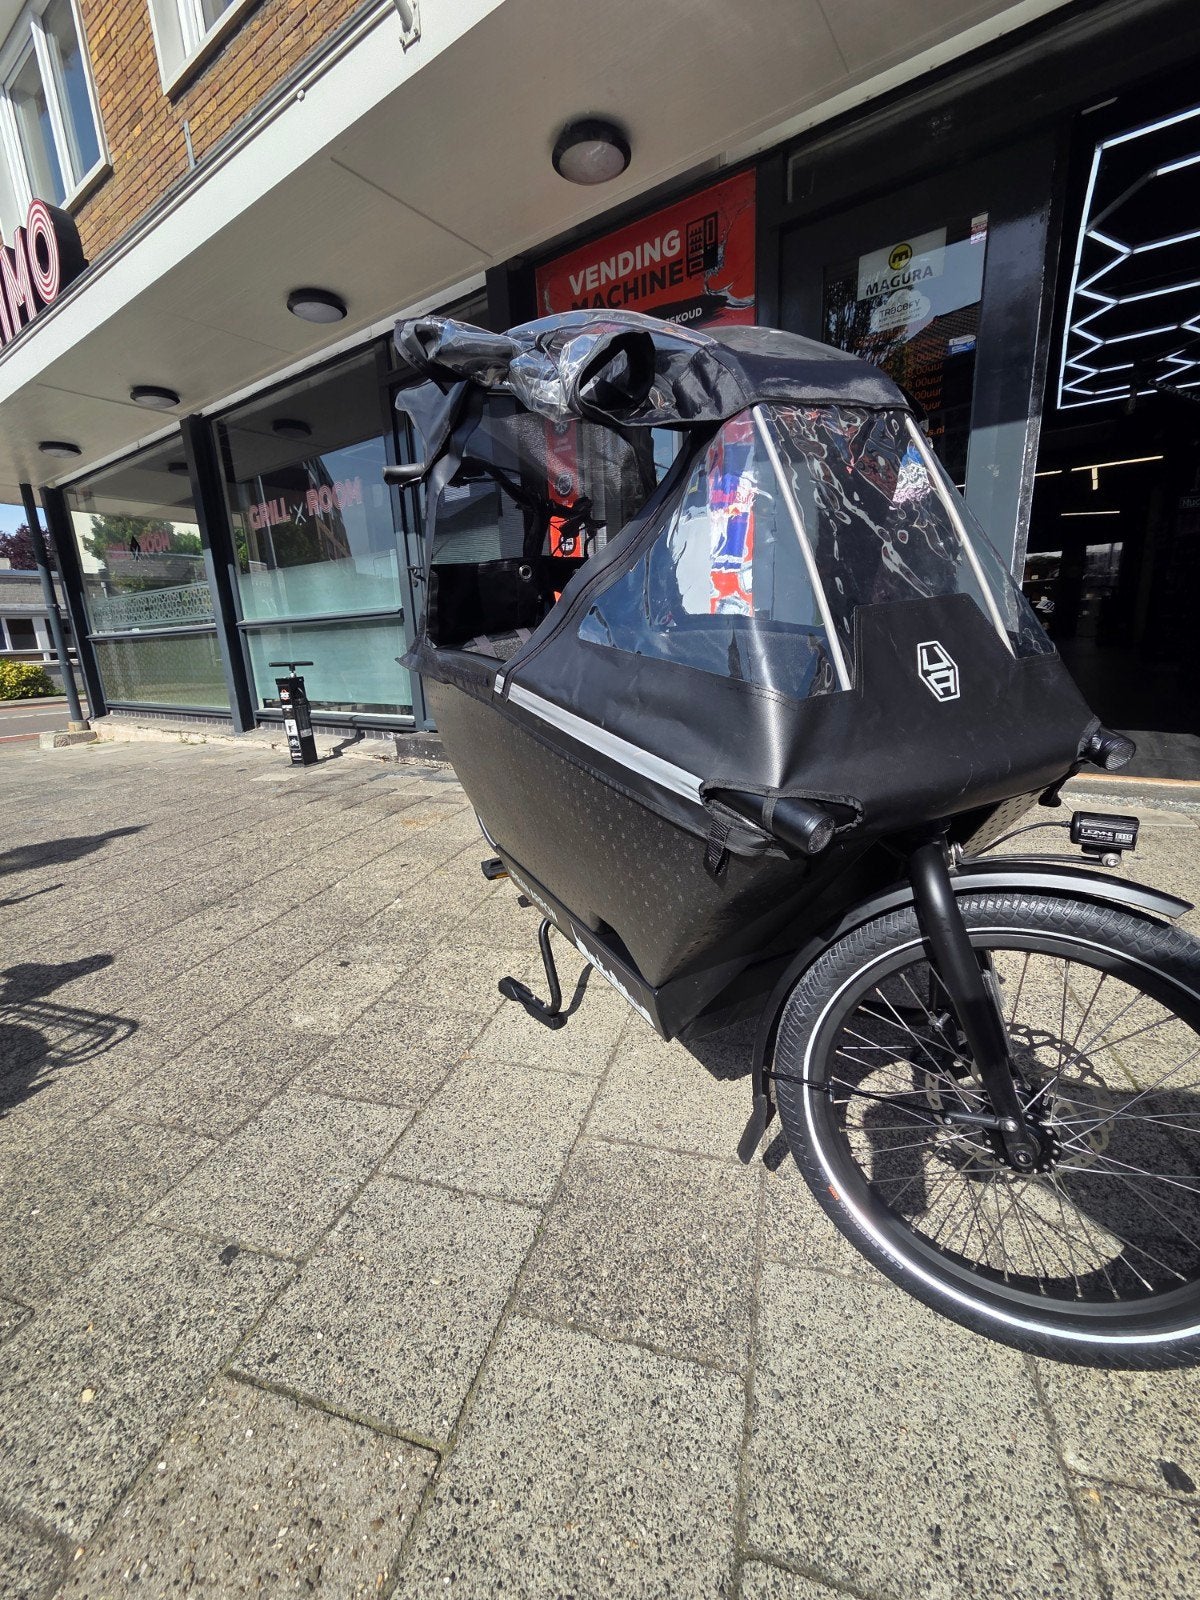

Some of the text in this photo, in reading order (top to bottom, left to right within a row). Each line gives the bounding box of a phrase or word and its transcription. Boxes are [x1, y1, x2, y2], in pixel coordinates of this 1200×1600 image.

[0, 198, 60, 347] IMO
[569, 229, 681, 296] VENDING
[865, 265, 933, 296] MAGURA
[247, 497, 292, 529] GRILL
[306, 476, 363, 517] ROOM
